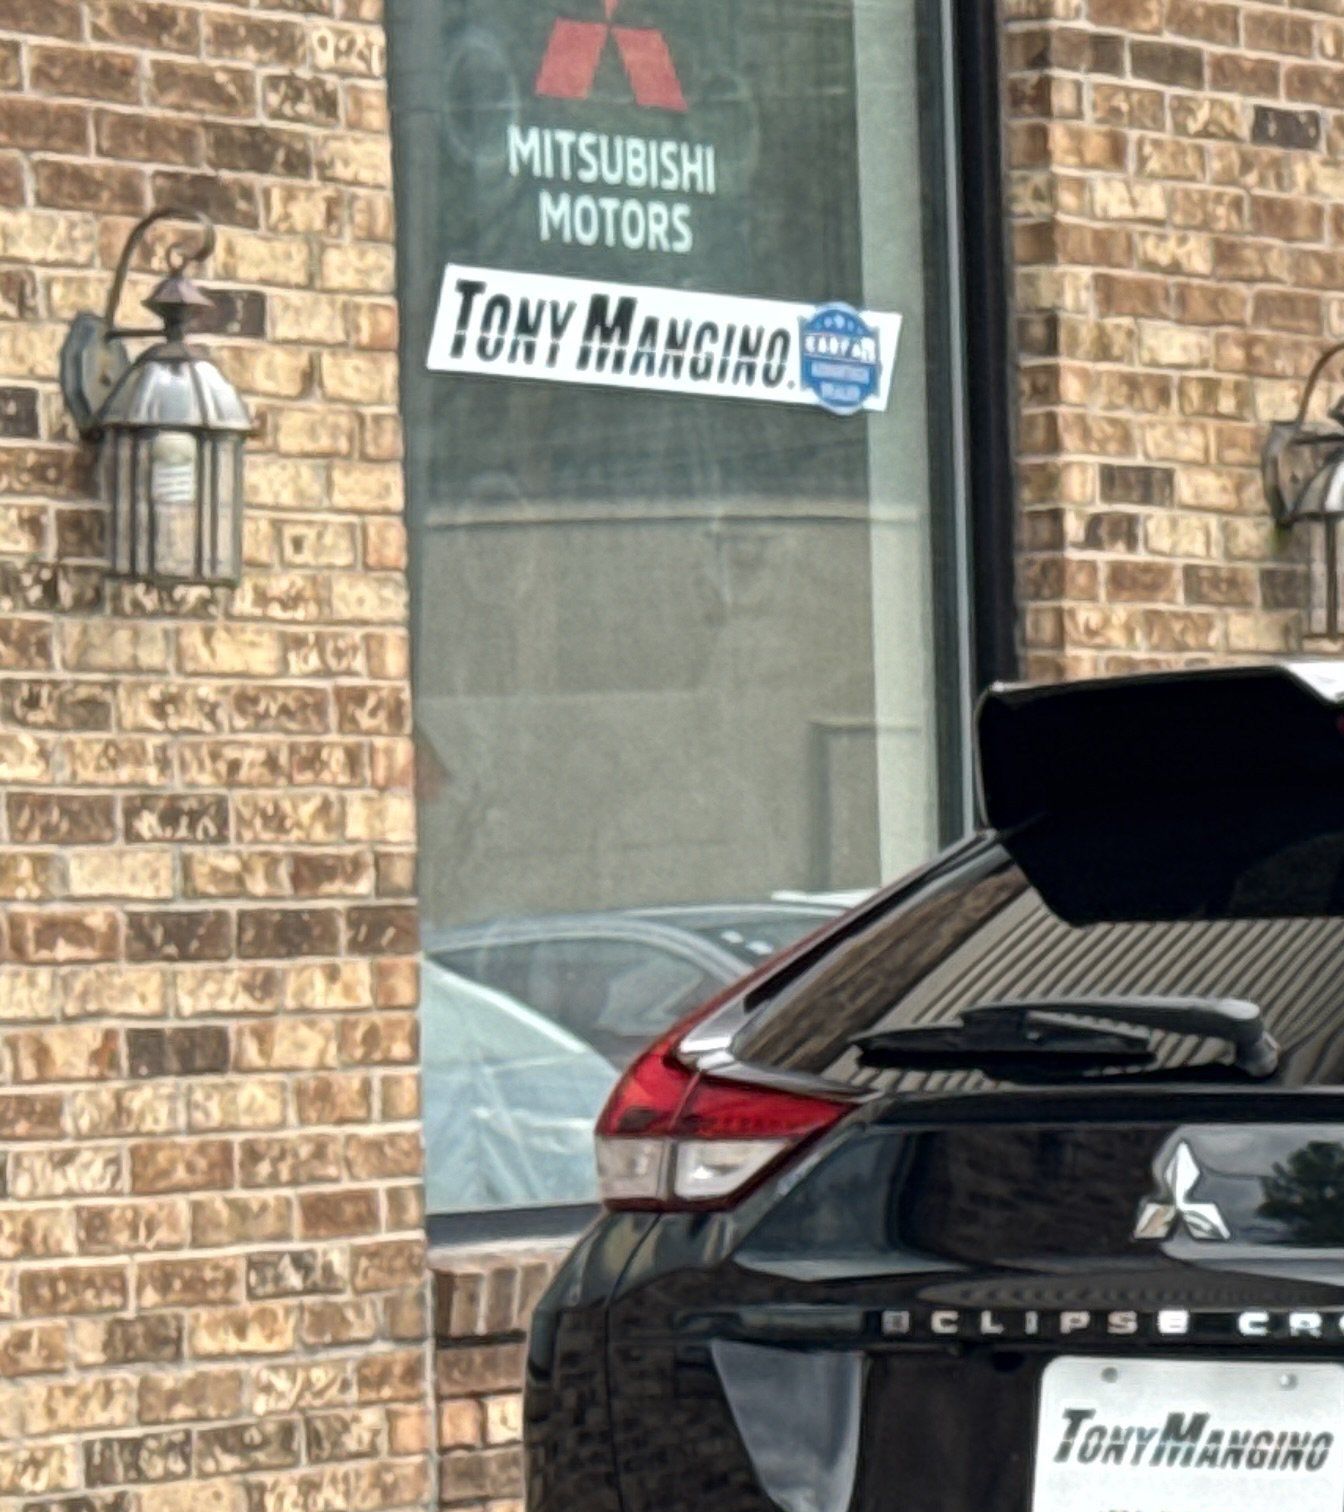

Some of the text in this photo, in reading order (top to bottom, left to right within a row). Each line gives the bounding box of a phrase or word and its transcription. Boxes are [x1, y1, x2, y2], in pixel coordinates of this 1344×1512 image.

[507, 124, 716, 194] MITSUBISHI
[539, 190, 693, 253] MOTORS
[449, 278, 794, 390] TONY MANGINO
[880, 1309, 1190, 1336] ECLIPSE
